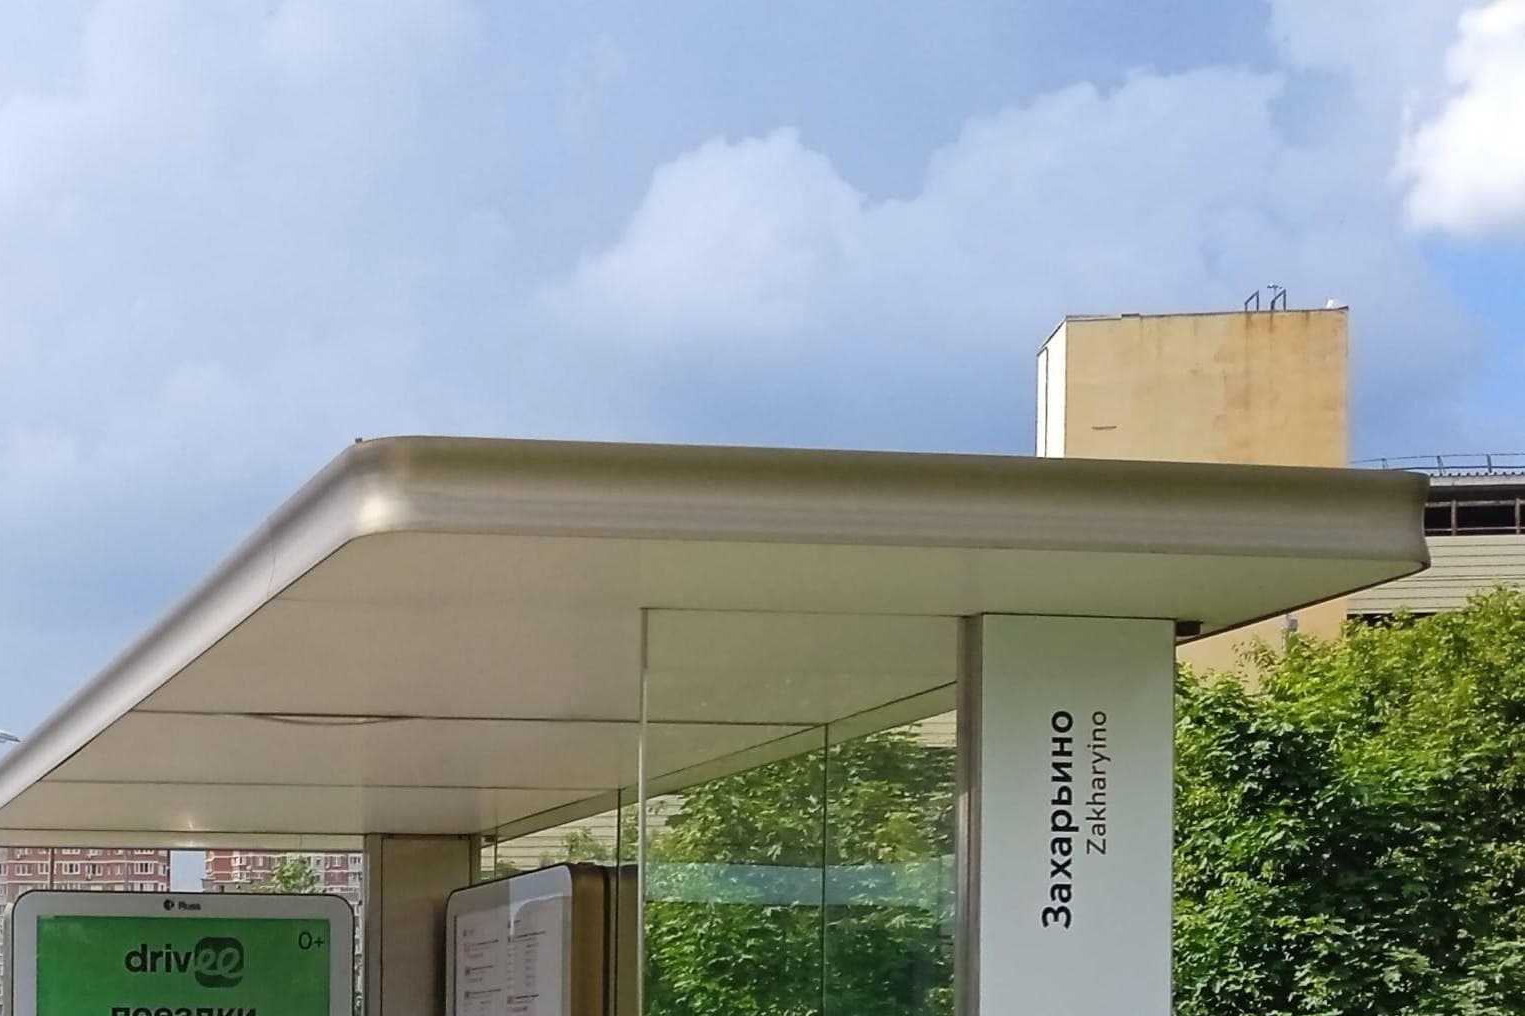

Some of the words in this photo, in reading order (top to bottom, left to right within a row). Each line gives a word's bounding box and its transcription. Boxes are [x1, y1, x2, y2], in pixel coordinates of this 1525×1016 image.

[1041, 710, 1079, 929] Захарьино
[1085, 711, 1111, 855] Zakharyino
[124, 941, 244, 979] drivee
[298, 931, 325, 950] 0+
